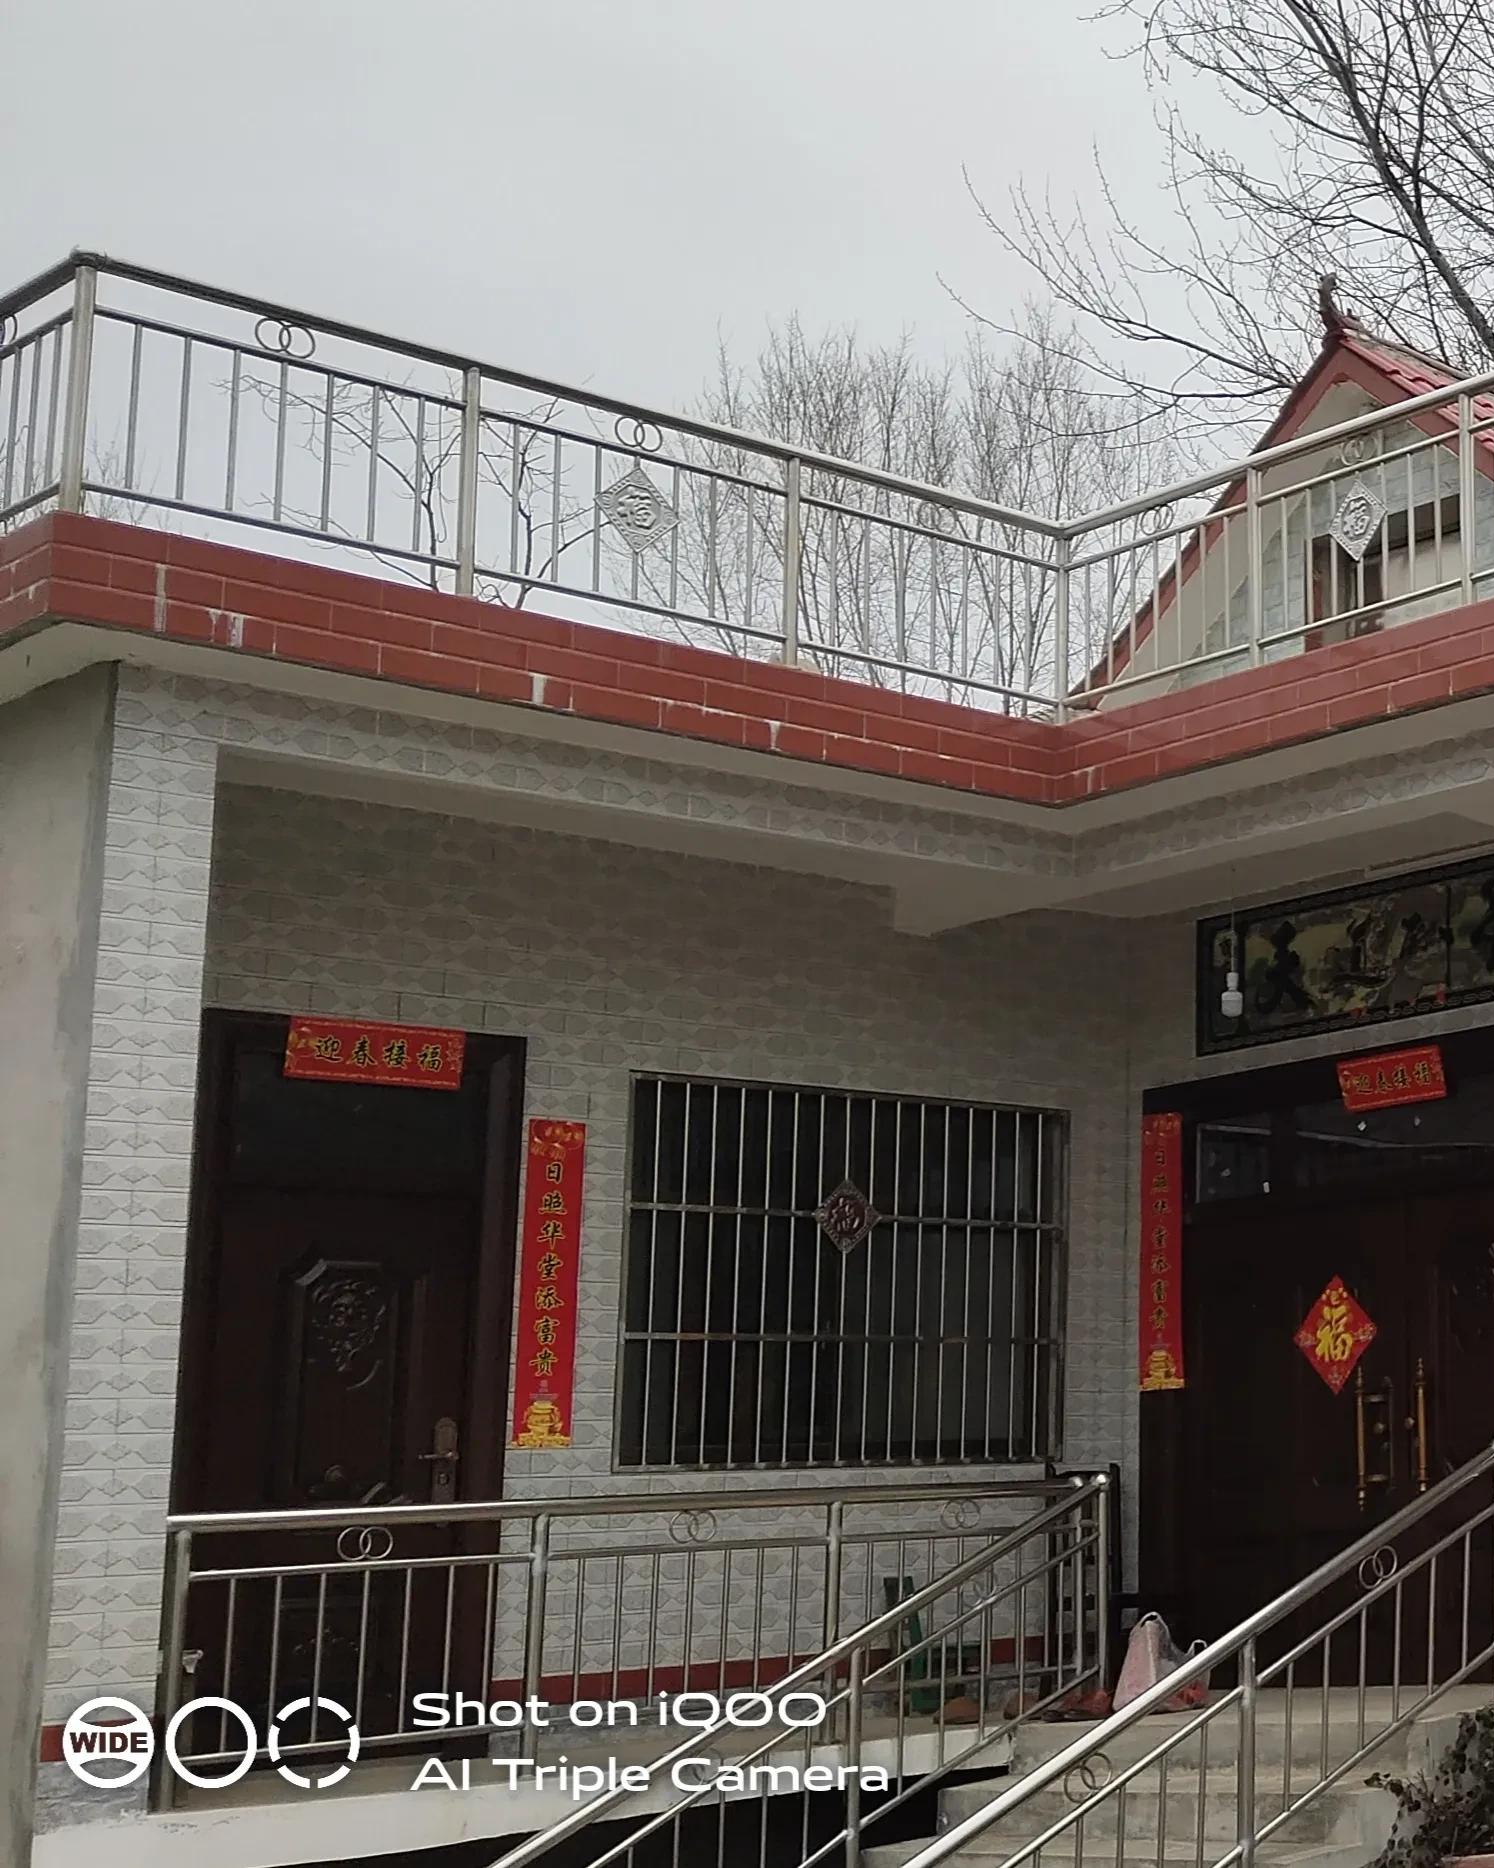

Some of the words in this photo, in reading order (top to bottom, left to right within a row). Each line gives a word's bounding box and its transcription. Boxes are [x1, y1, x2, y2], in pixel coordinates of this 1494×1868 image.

[313, 1034, 444, 1074] 迎春接福
[528, 1160, 568, 1378] 日照华堂添富贵
[1314, 1304, 1354, 1364] 福
